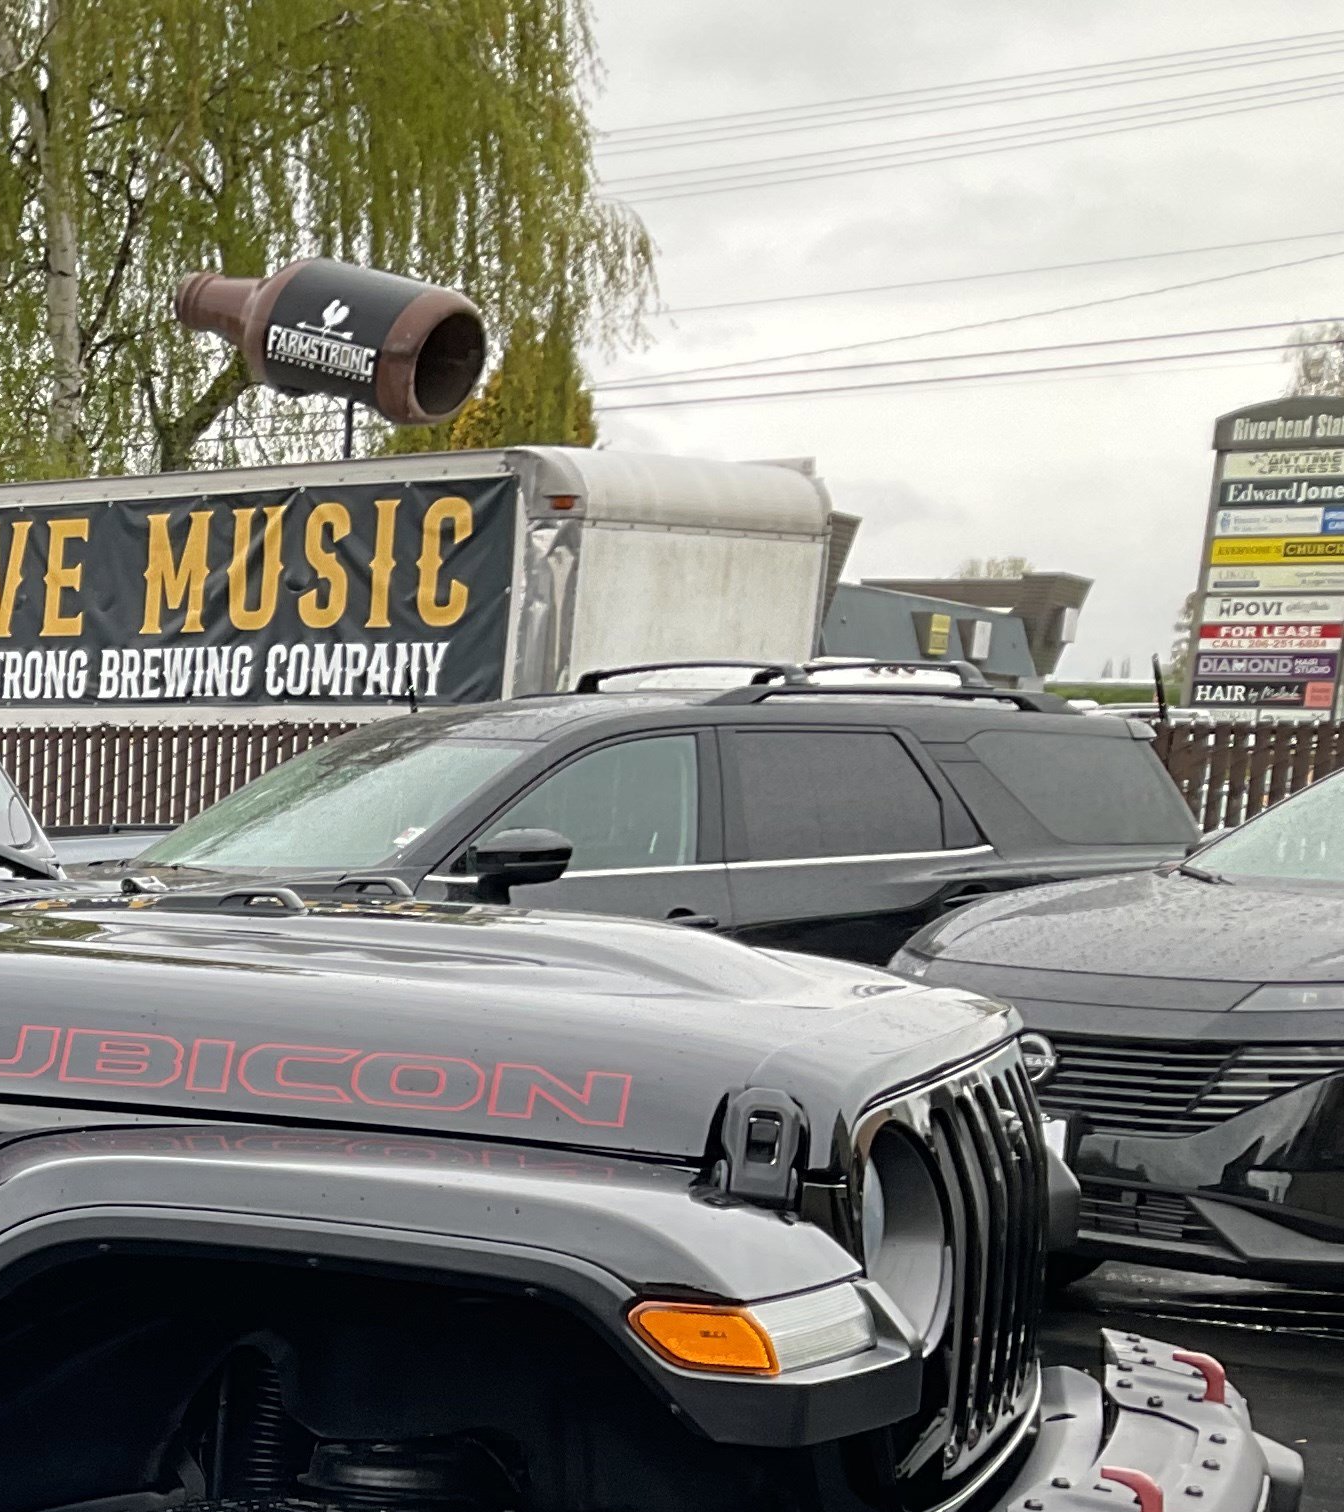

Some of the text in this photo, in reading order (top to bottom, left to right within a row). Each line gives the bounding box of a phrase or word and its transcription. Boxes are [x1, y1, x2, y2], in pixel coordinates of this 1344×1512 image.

[267, 324, 377, 376] FARMSTRONG
[1315, 413, 1344, 438] Sta
[1227, 481, 1298, 503] Edward
[139, 496, 474, 635] MUSIC
[1220, 625, 1323, 638] FOR LEASE
[1211, 639, 1243, 650] CALL
[98, 645, 254, 699] BREWING
[265, 641, 450, 697] COMPANY
[1197, 657, 1293, 673] DIAMOND
[1195, 684, 1247, 702] HAIR
